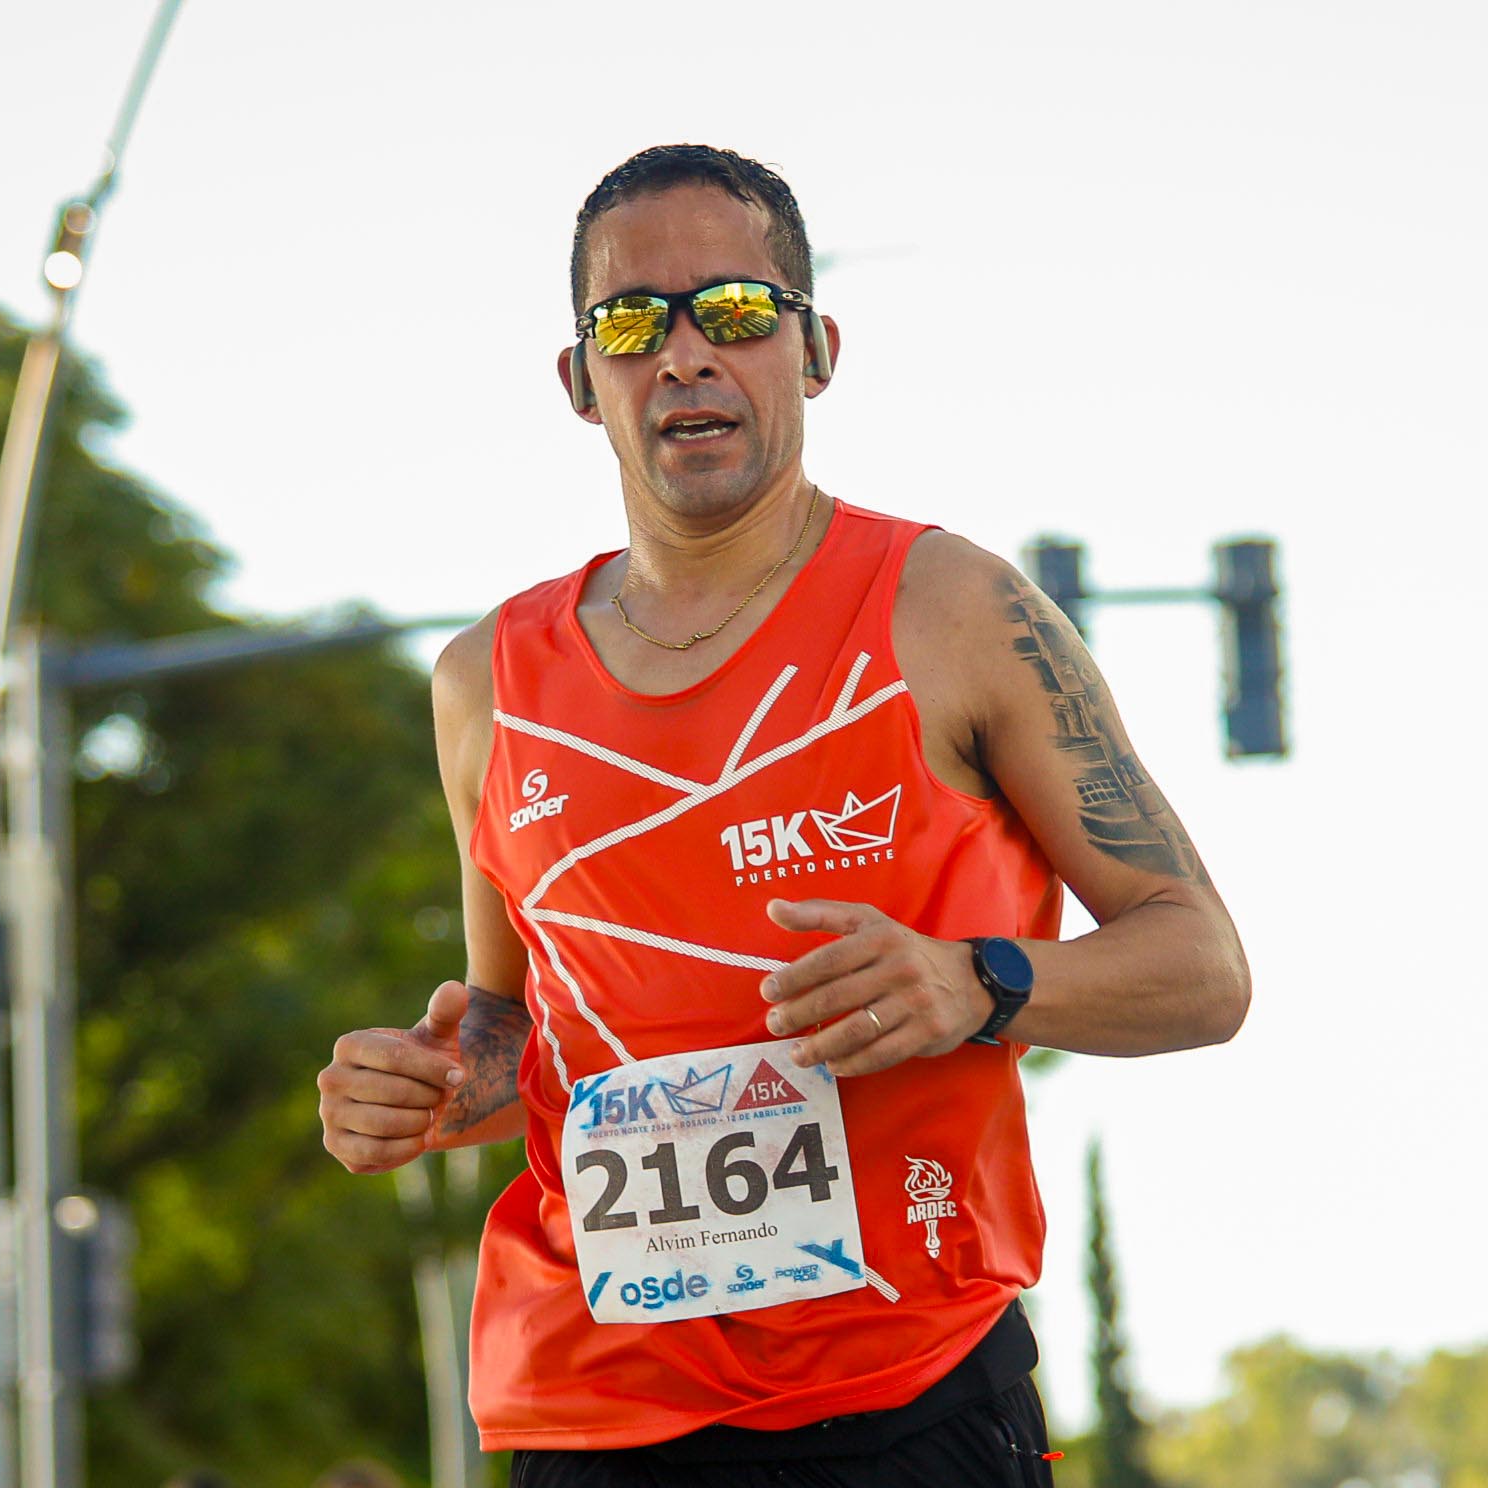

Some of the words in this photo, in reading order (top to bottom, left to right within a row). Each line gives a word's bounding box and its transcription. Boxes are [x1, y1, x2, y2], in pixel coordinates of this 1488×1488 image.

[720, 811, 814, 871] 15K
[735, 862, 816, 887] PUERTO
[825, 849, 894, 871] NORTE
[588, 1081, 658, 1127] 15K
[747, 1078, 787, 1102] 15K
[587, 1129, 619, 1139] PUERTO
[621, 1126, 648, 1136] NORTE
[680, 1118, 717, 1129] ROSARIO
[726, 1115, 737, 1123] 12
[739, 1113, 751, 1121] DE
[753, 1110, 780, 1118] ABRIL
[575, 1122, 839, 1232] 2164
[906, 1200, 958, 1224] ARDEC
[646, 1233, 696, 1253] Alvim
[701, 1223, 779, 1247] Fernando
[775, 1264, 819, 1280] POWER
[620, 1270, 709, 1310] osde
